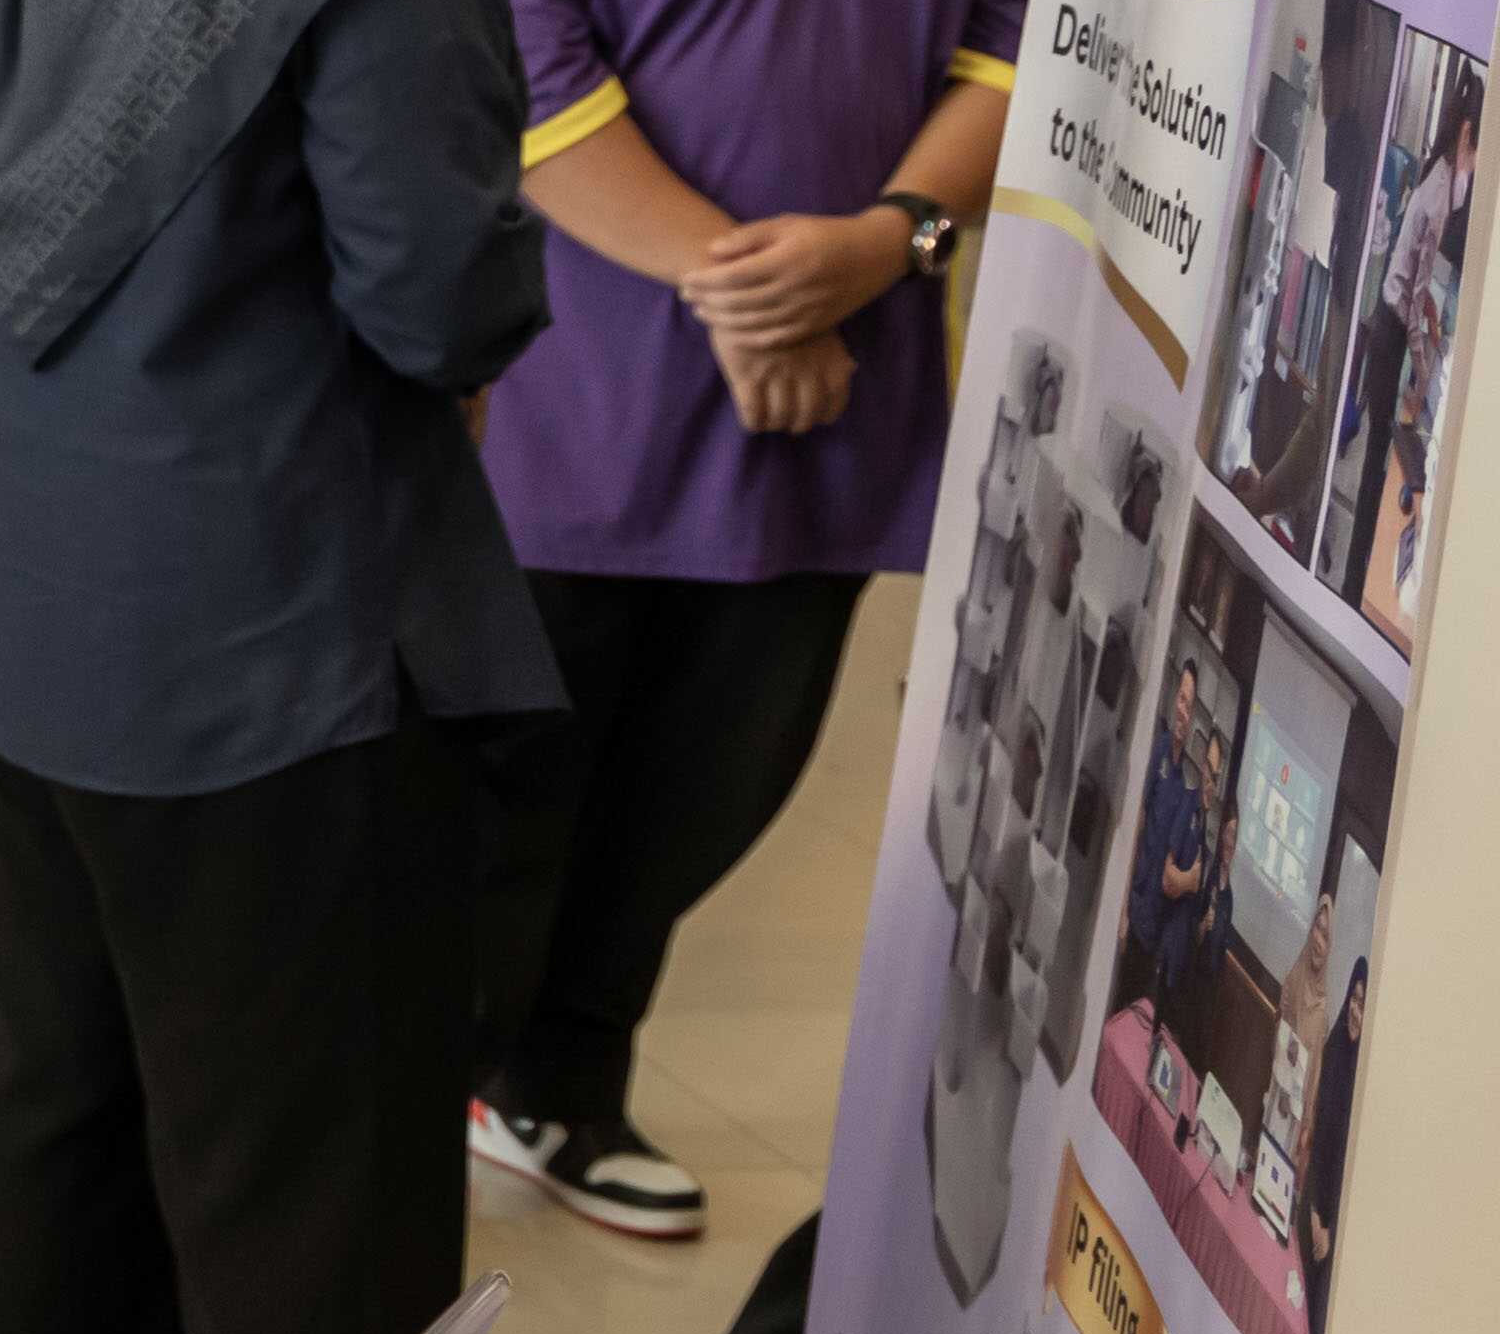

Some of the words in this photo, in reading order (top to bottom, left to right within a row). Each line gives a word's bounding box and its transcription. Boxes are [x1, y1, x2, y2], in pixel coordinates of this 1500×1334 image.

[1051, 107, 1077, 162] to
[1079, 117, 1105, 184] the
[1139, 59, 1227, 160] Solution
[1066, 1201, 1089, 1264] IP
